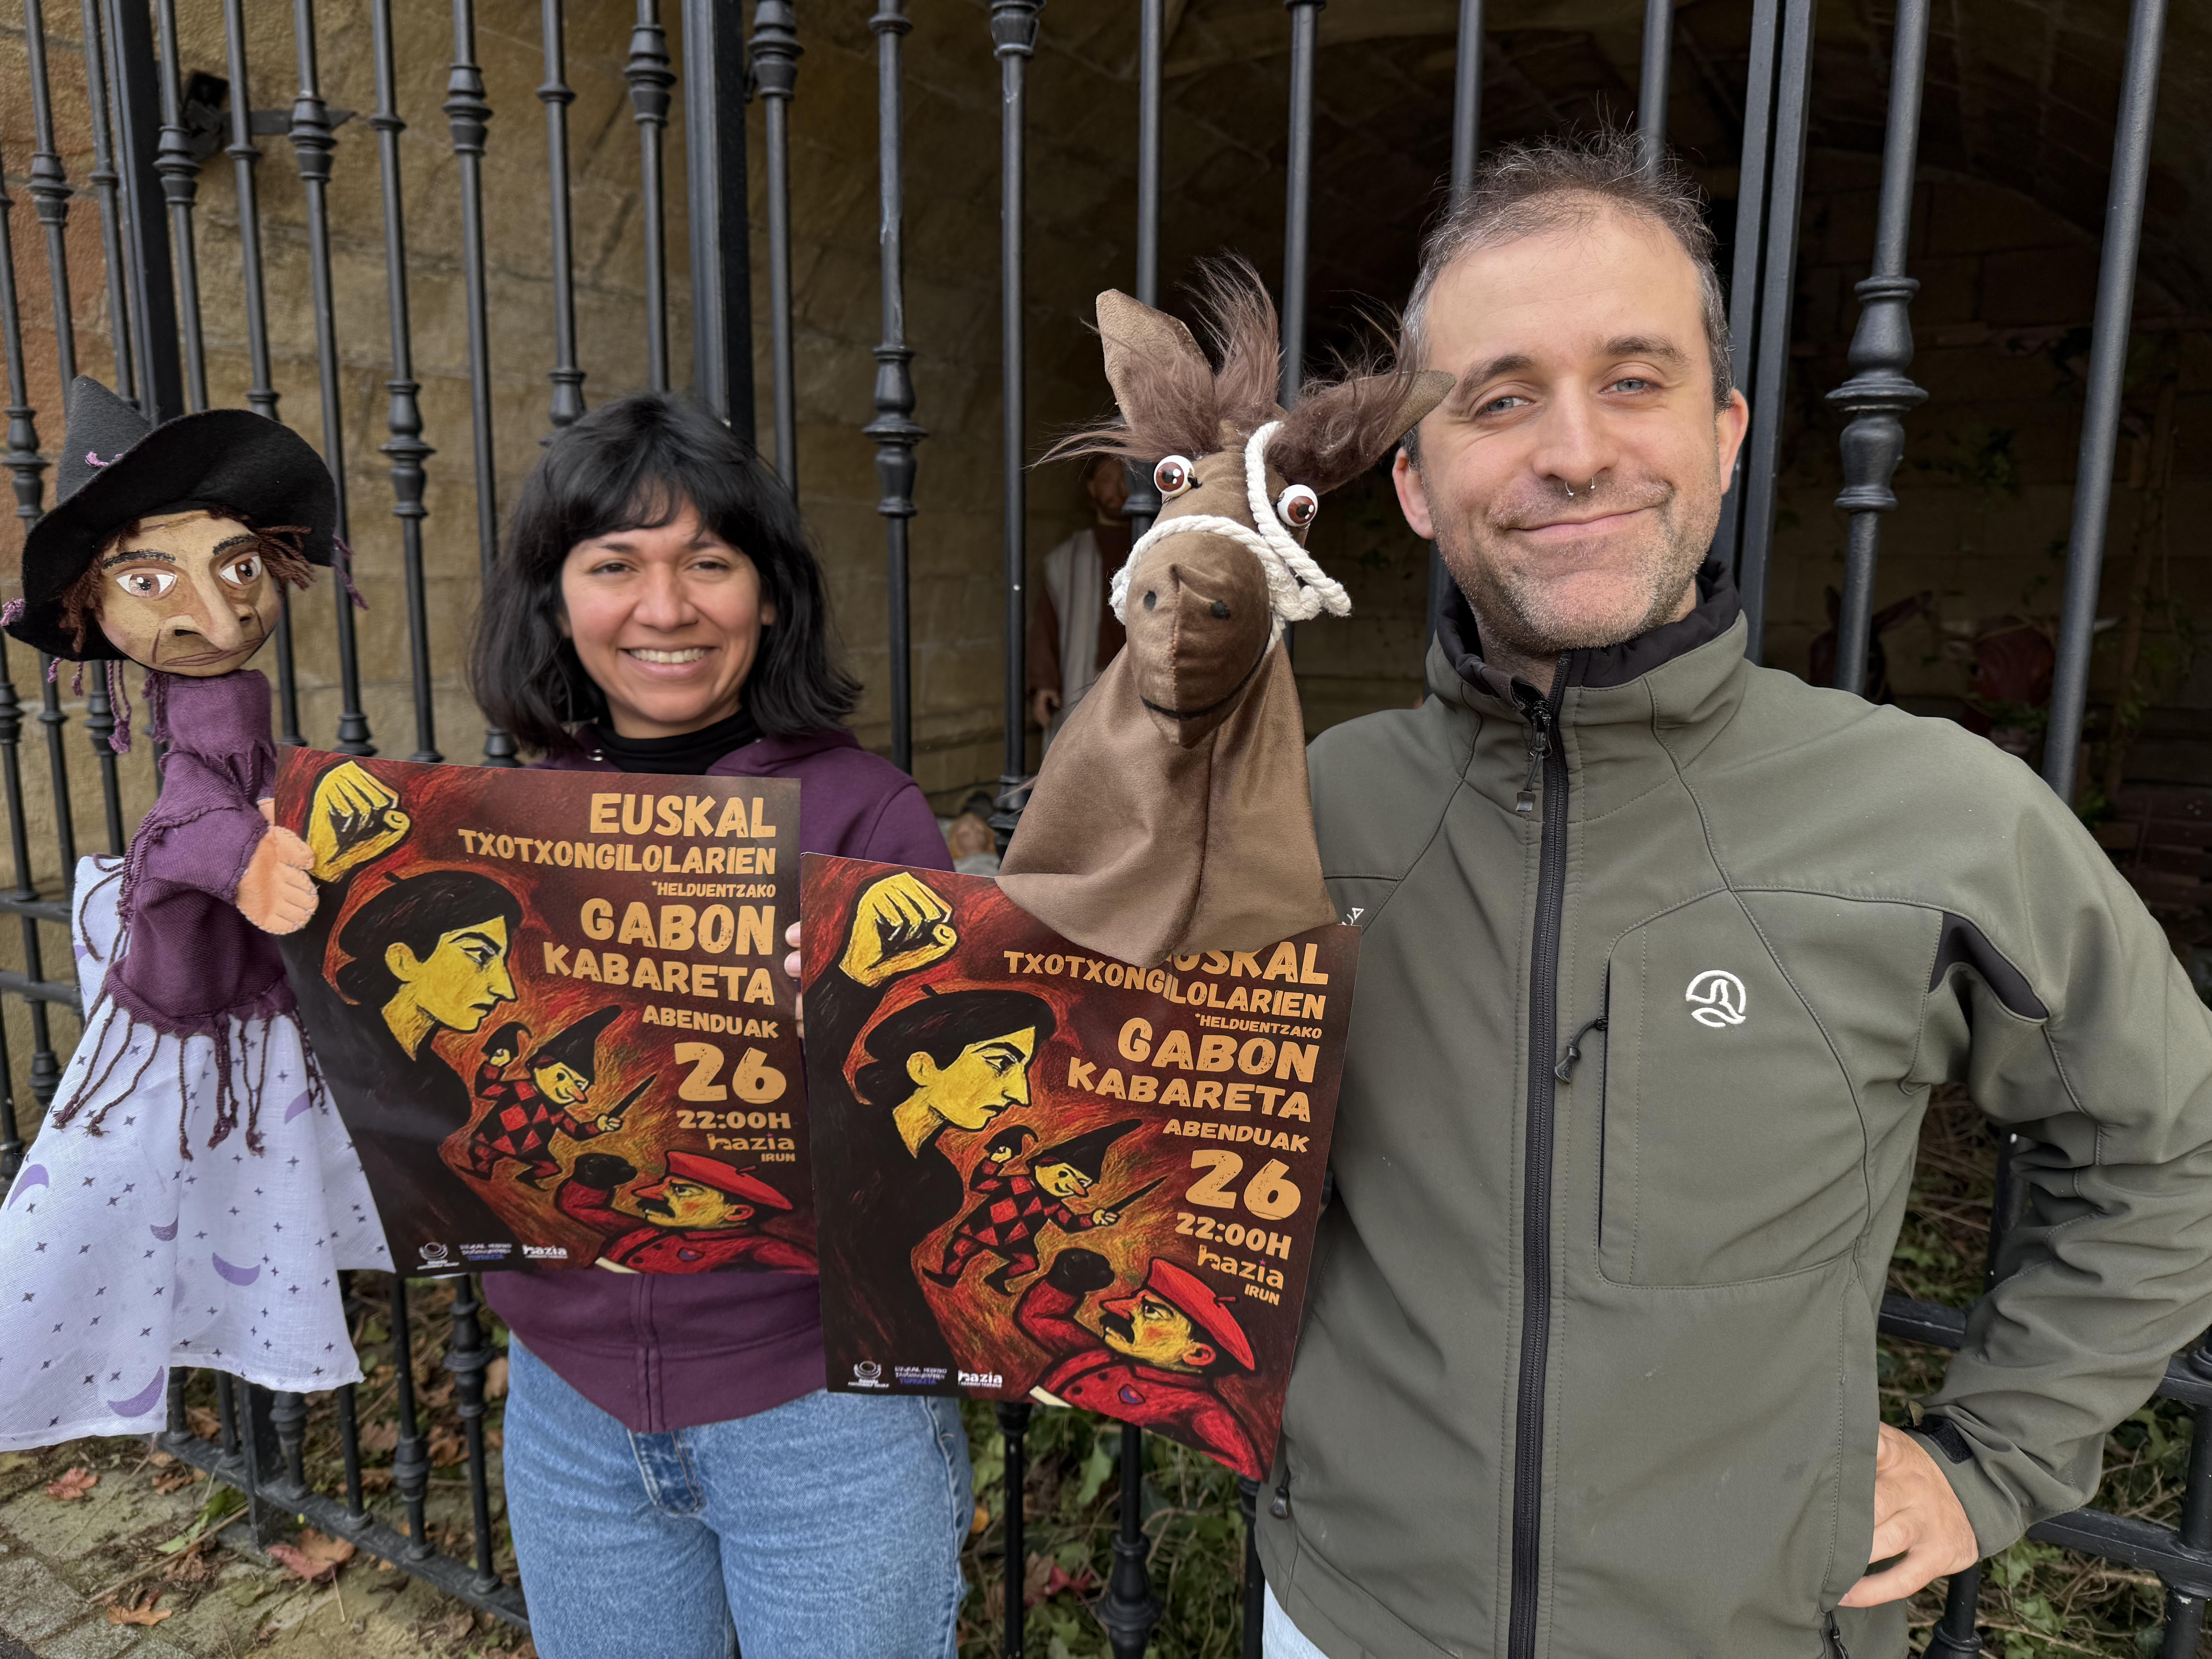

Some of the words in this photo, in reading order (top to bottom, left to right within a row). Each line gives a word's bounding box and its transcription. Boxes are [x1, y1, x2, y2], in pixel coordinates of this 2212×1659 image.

[590, 793, 776, 838] EUSKAL
[458, 828, 776, 874] TXOTXONGILOLARIEN
[581, 898, 775, 955] GABON
[543, 942, 775, 1006] KABARETA
[1004, 950, 1326, 1020] TXOTXONGILOLARIEN
[1166, 941, 1328, 984] SKAL
[642, 1005, 779, 1039] ABENDUAK
[675, 1042, 787, 1104] 26
[1118, 1017, 1320, 1083] GABON
[1068, 1057, 1310, 1122] KABARETA
[677, 1110, 792, 1129] 22:00H
[1163, 1119, 1310, 1153] ABENDUAK
[761, 1153, 795, 1162] IRUN
[1185, 1149, 1301, 1220] 26
[1175, 1212, 1292, 1260] 22:00H
[1245, 1284, 1279, 1306] IRUN
